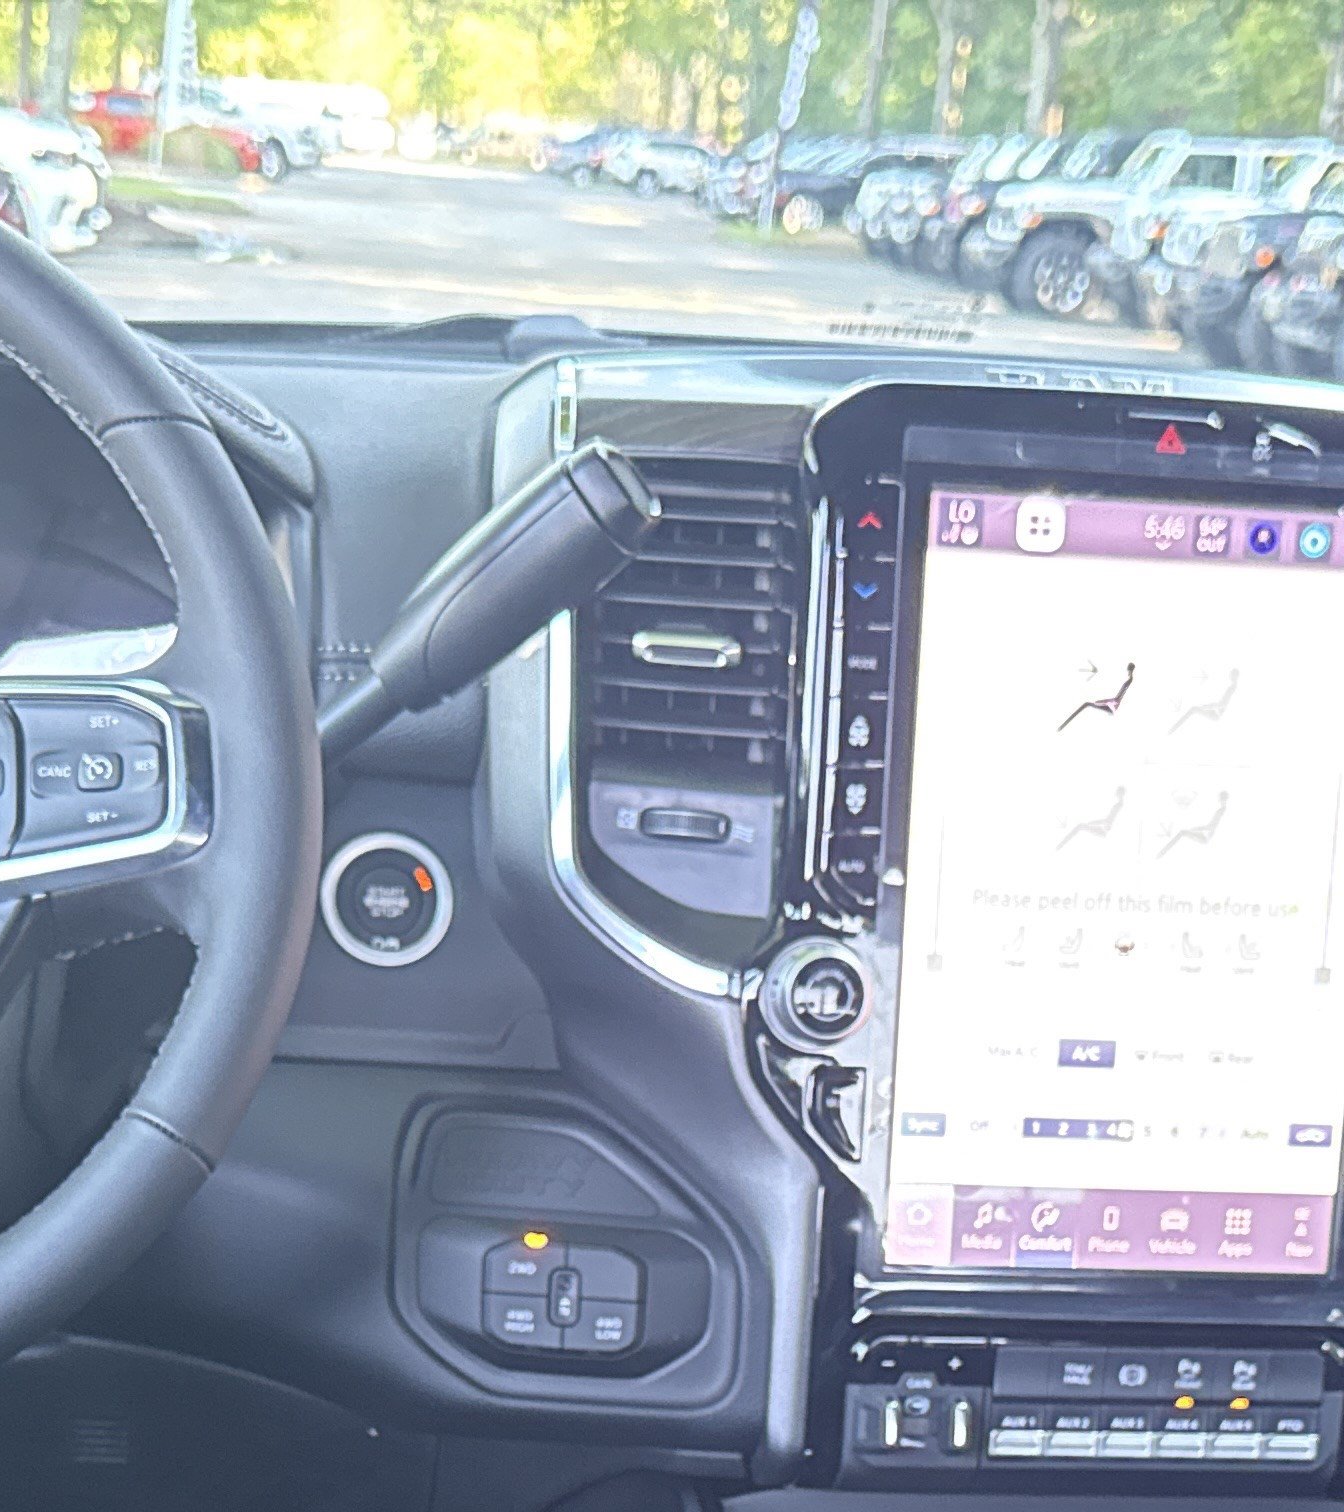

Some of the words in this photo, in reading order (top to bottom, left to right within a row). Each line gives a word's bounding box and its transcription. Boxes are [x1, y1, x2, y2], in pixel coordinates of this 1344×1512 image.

[948, 499, 976, 526] LO
[1144, 513, 1186, 541] 5:46
[38, 766, 72, 779] CANC
[134, 760, 156, 773] RES
[972, 889, 1031, 910] Please
[1037, 892, 1078, 913] peel
[1084, 893, 1112, 912] off
[1118, 895, 1151, 914] this
[1158, 895, 1193, 914] film
[1199, 897, 1261, 917] before
[1268, 903, 1300, 919] use
[1071, 1044, 1102, 1064] A/C
[906, 1116, 942, 1135] Sync
[961, 1233, 1003, 1252] Media
[1018, 1234, 1073, 1253] Comfort
[1088, 1236, 1131, 1255] Phone
[1149, 1237, 1197, 1257] Vehicle
[1218, 1240, 1254, 1260] Apps
[506, 1261, 537, 1275] 2WD
[506, 1309, 534, 1322] 4WD
[594, 1316, 623, 1329] 4WD
[594, 1328, 623, 1341] LOW
[1001, 1416, 1026, 1429] AUX
[1055, 1416, 1079, 1429] AUX
[1110, 1416, 1134, 1429] AUX
[1164, 1417, 1188, 1430] AUX
[1218, 1418, 1242, 1431] AUX
